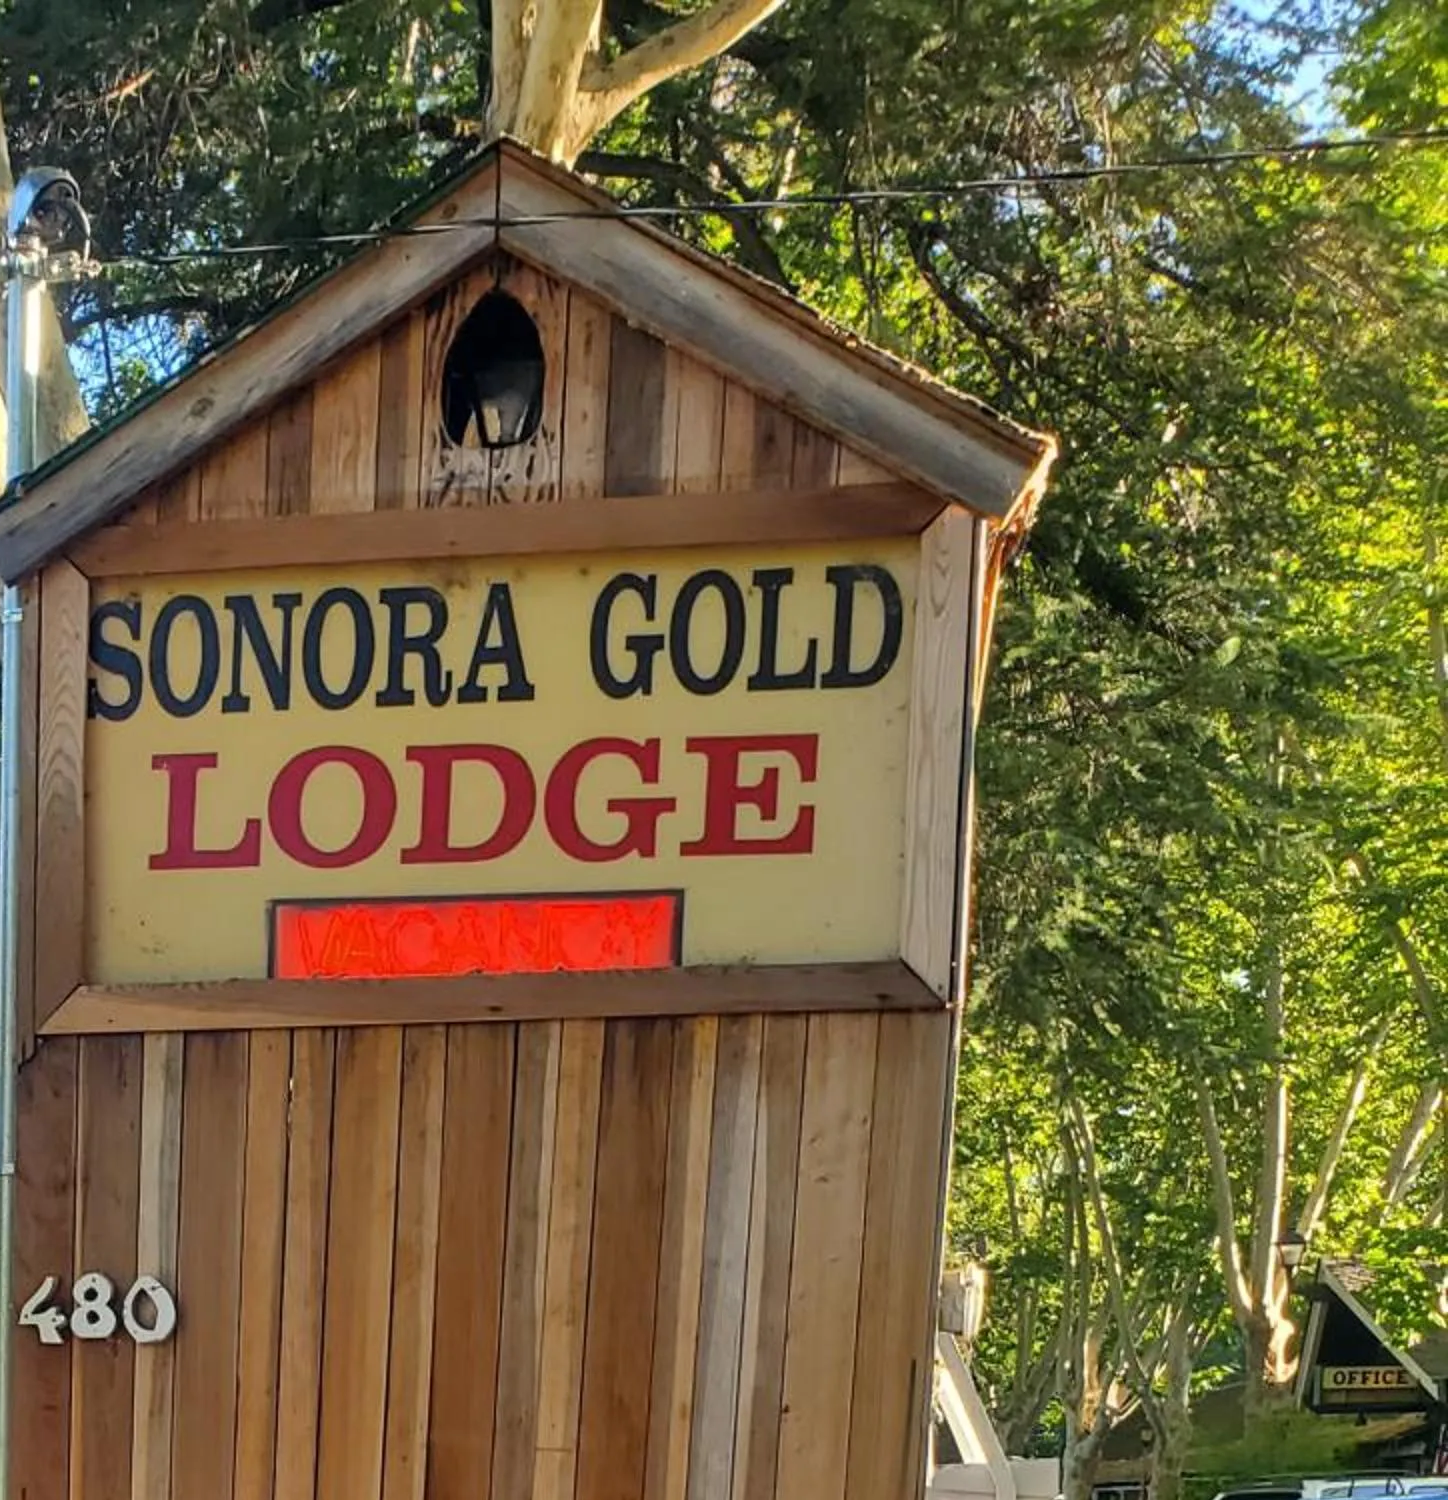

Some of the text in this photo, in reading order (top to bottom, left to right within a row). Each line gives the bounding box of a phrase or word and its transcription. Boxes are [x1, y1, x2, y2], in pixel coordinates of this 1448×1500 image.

[88, 564, 904, 722] SONORA GOLD
[149, 733, 820, 872] LODGE
[296, 898, 664, 976] VACANCY
[17, 1273, 177, 1345] 480
[1333, 1369, 1409, 1386] OFFICE
